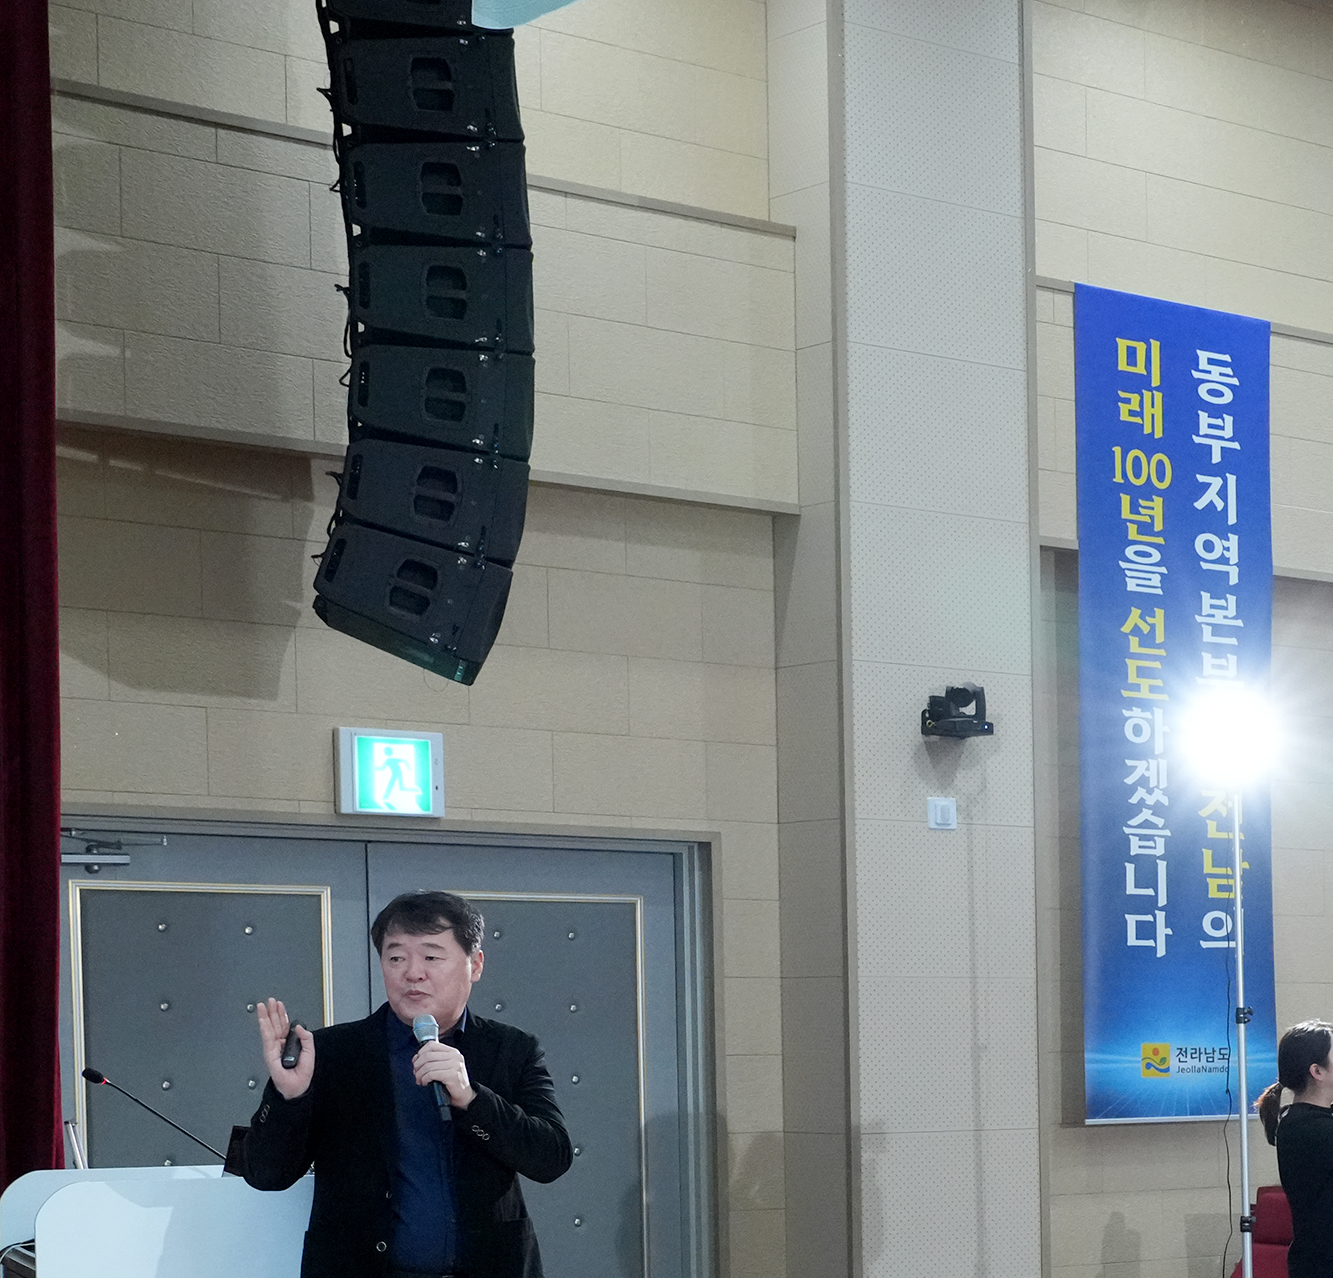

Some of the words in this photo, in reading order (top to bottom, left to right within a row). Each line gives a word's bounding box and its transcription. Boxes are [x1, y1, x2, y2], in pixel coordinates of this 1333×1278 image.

[1115, 337, 1163, 439] 미래
[1111, 445, 1173, 596] 100년을
[1191, 349, 1243, 690] 동부지역본부
[1120, 606, 1173, 958] 선도하겠습니다
[1198, 788, 1250, 956] 전남의
[1175, 1046, 1230, 1063] 전라남도
